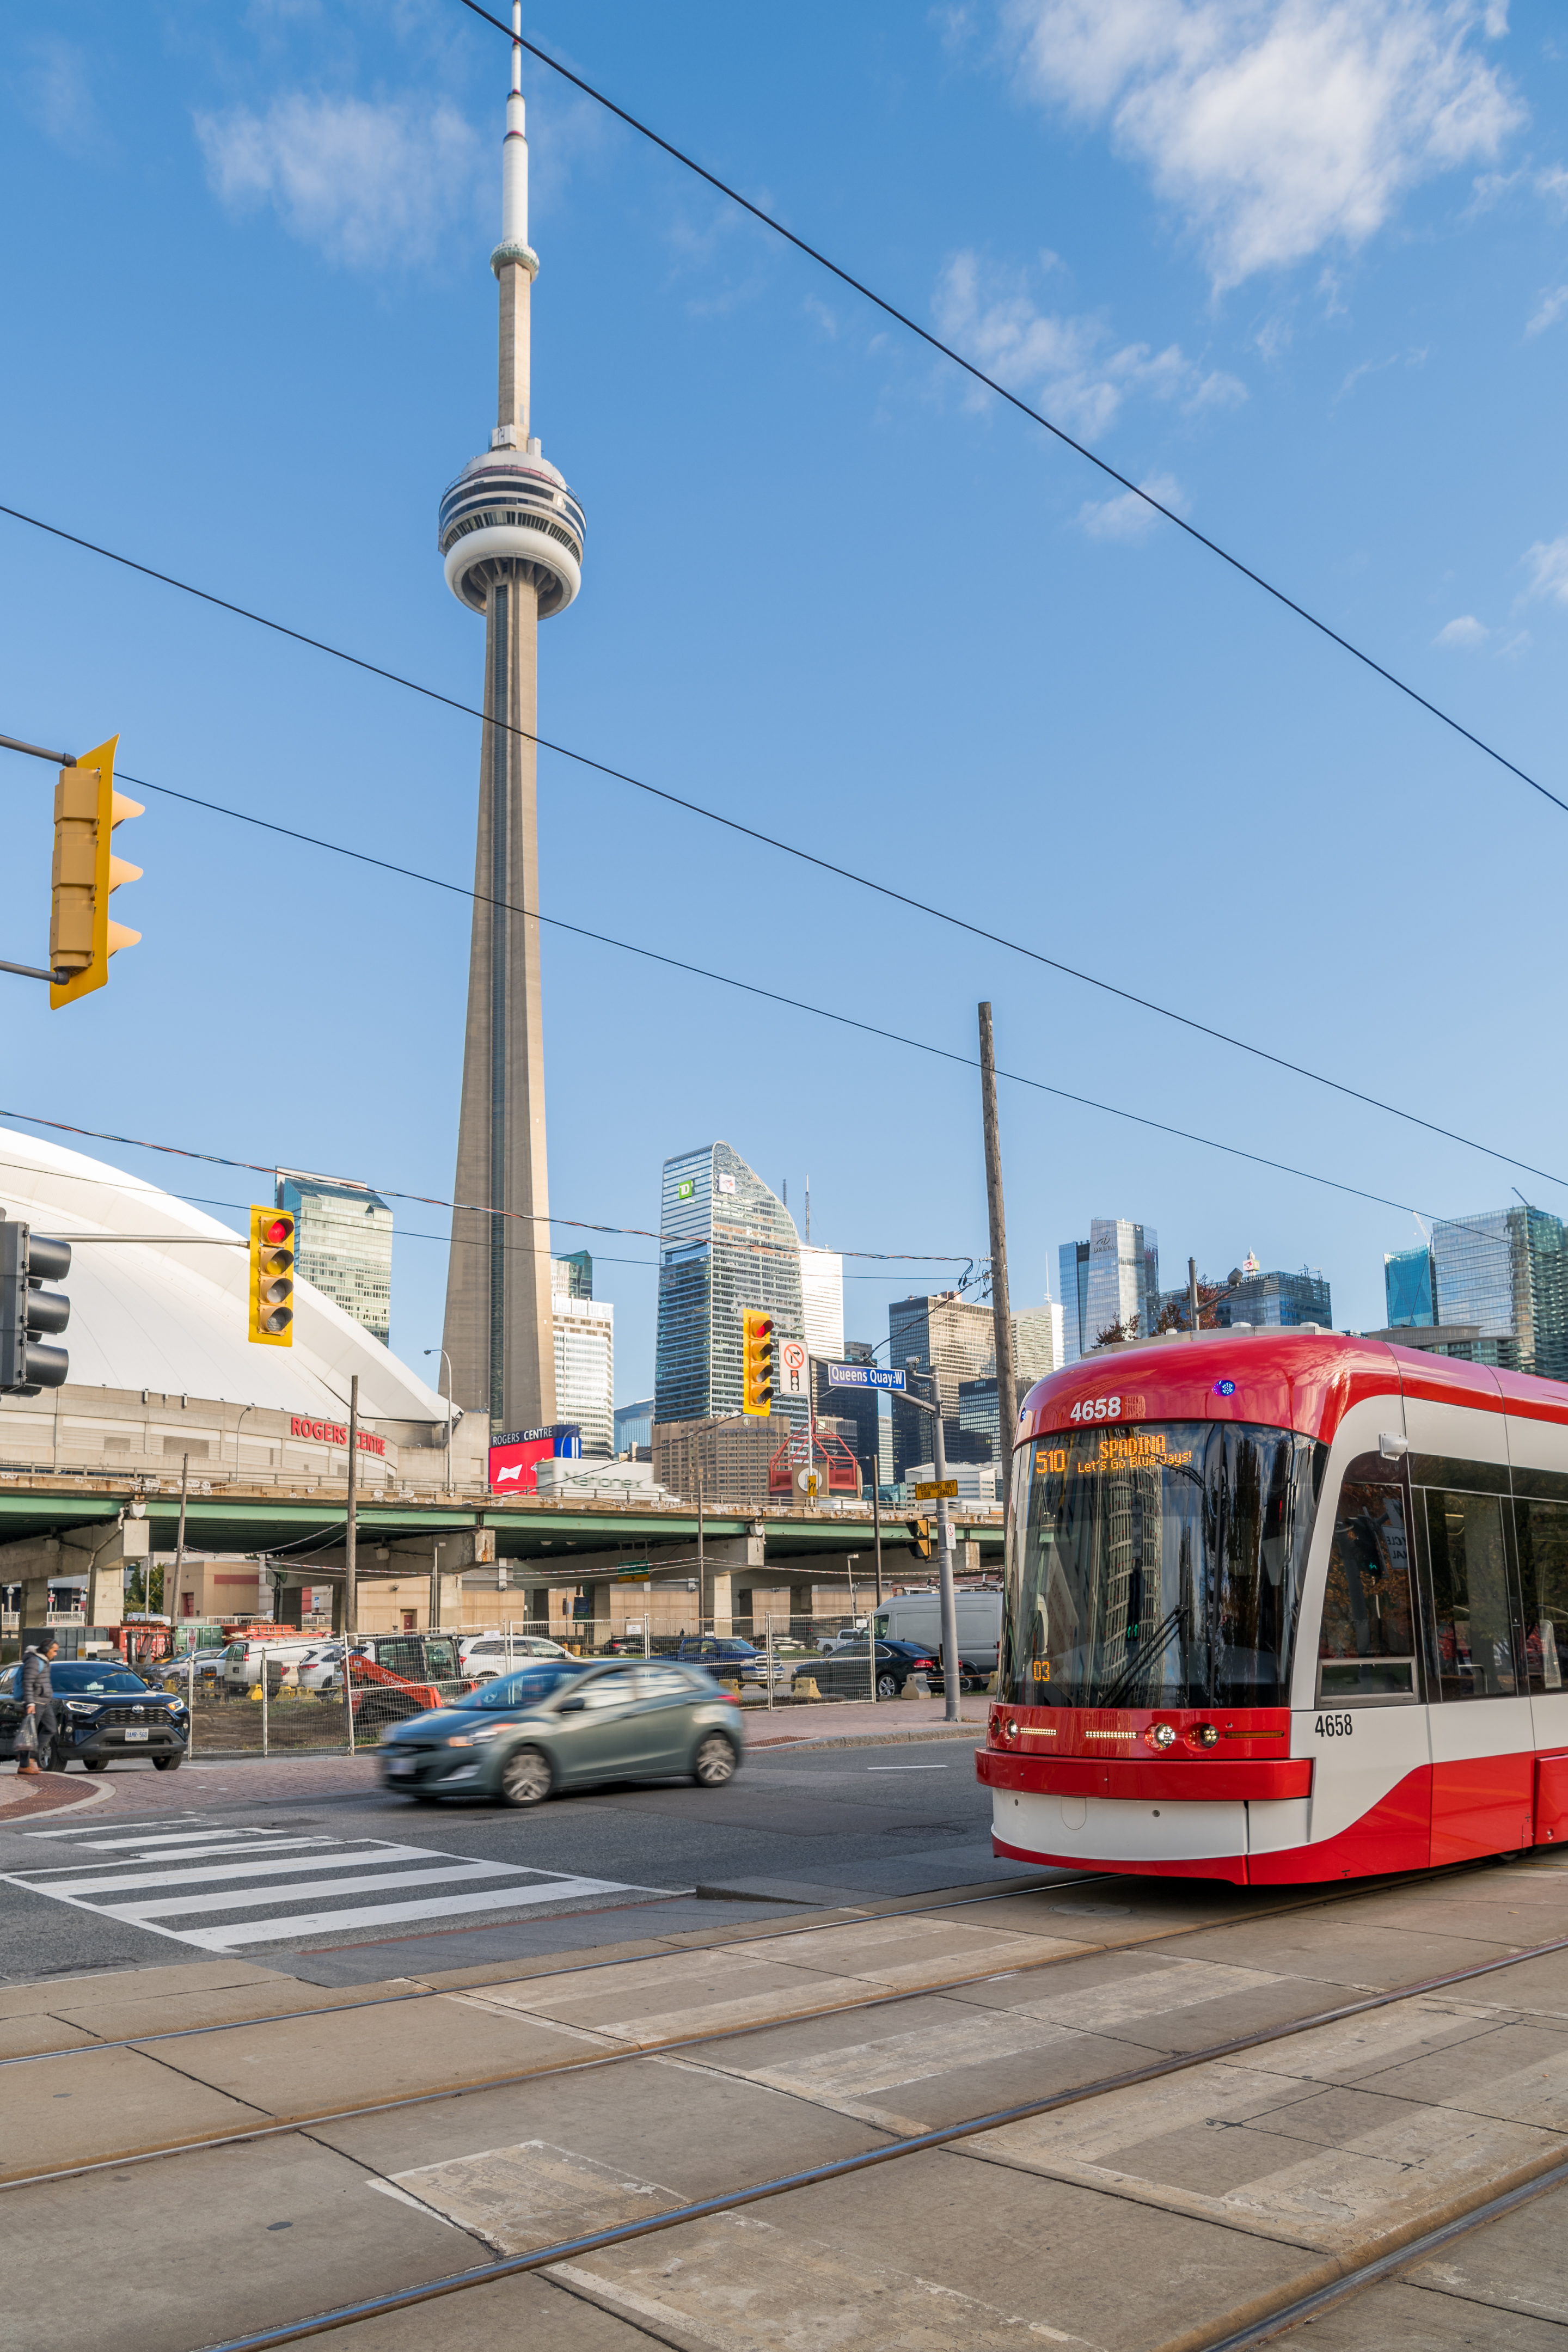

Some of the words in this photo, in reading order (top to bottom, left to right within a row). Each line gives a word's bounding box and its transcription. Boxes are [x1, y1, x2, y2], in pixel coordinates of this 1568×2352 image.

[679, 1183, 690, 1196] TD
[1093, 1245, 1114, 1253] DELTA
[831, 1366, 868, 1382] Queens
[869, 1369, 893, 1387] Quay
[1070, 1396, 1121, 1422] 4658
[291, 1417, 347, 1445] ROGERS
[493, 1432, 520, 1446] ROGERS
[524, 1426, 553, 1441] CENTRE
[1036, 1449, 1065, 1474] 510
[1099, 1435, 1166, 1459] SPADINA
[1077, 1460, 1107, 1473] Let's
[1111, 1459, 1126, 1469] Go
[1129, 1455, 1156, 1468] Blue
[1160, 1450, 1192, 1466] Jays!
[563, 1471, 644, 1489] Nationex
[918, 1483, 942, 1492] PEDESTRIANS
[1033, 1661, 1050, 1681] 03
[1315, 1713, 1353, 1737] 4658
